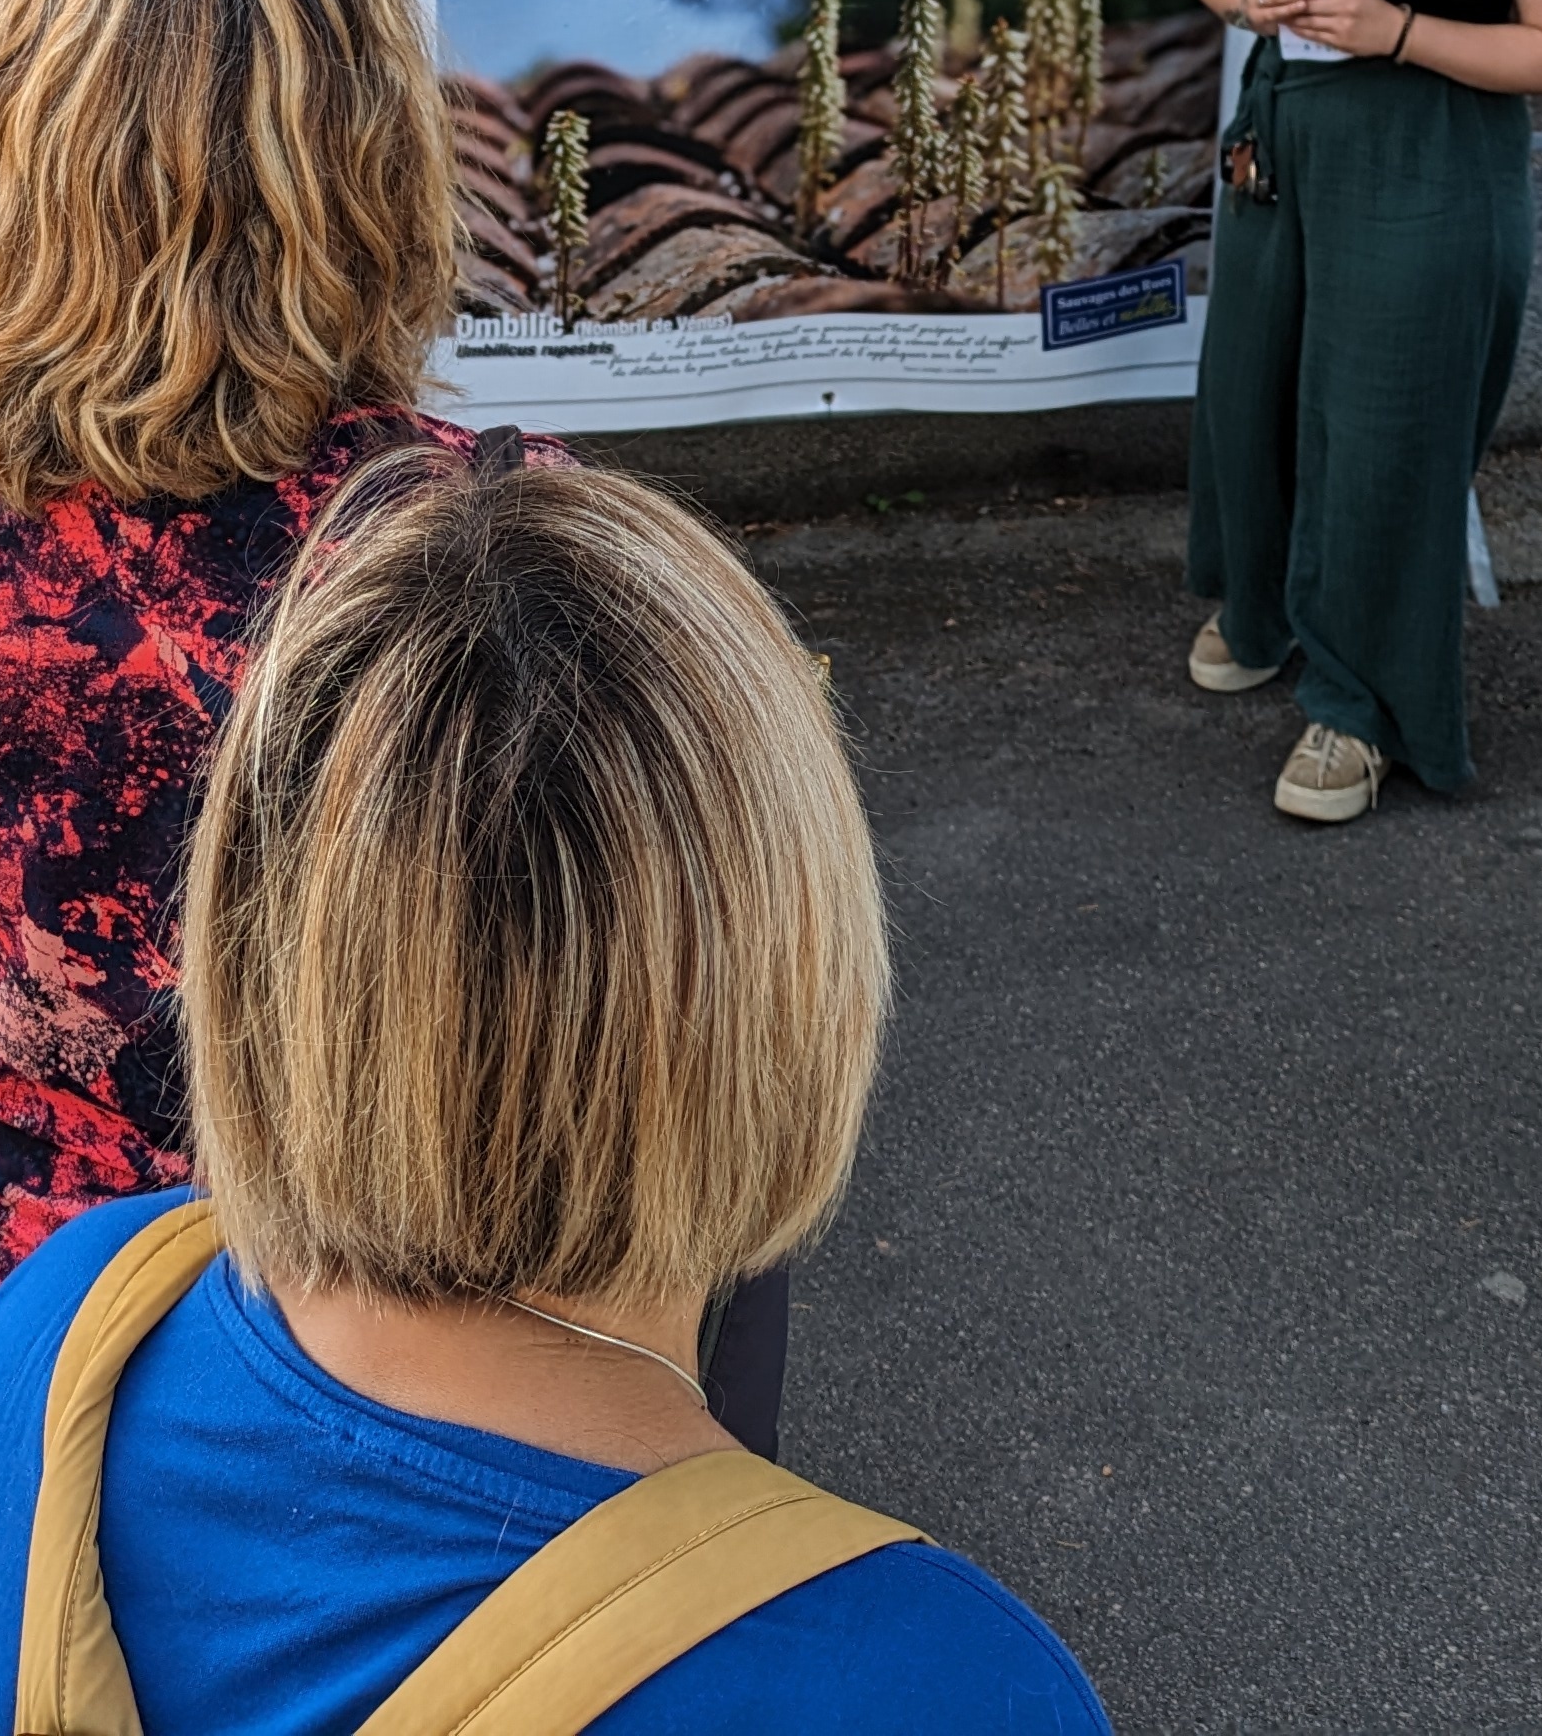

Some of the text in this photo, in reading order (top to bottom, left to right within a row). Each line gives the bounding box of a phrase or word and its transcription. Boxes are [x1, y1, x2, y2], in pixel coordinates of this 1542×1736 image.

[1057, 277, 1172, 310] Sauvages des Rues
[456, 312, 565, 340] Ombilic
[652, 315, 673, 333] de
[1059, 317, 1100, 335] Belles
[1102, 311, 1116, 327] et
[456, 341, 615, 359] Umbilicus rupestris
